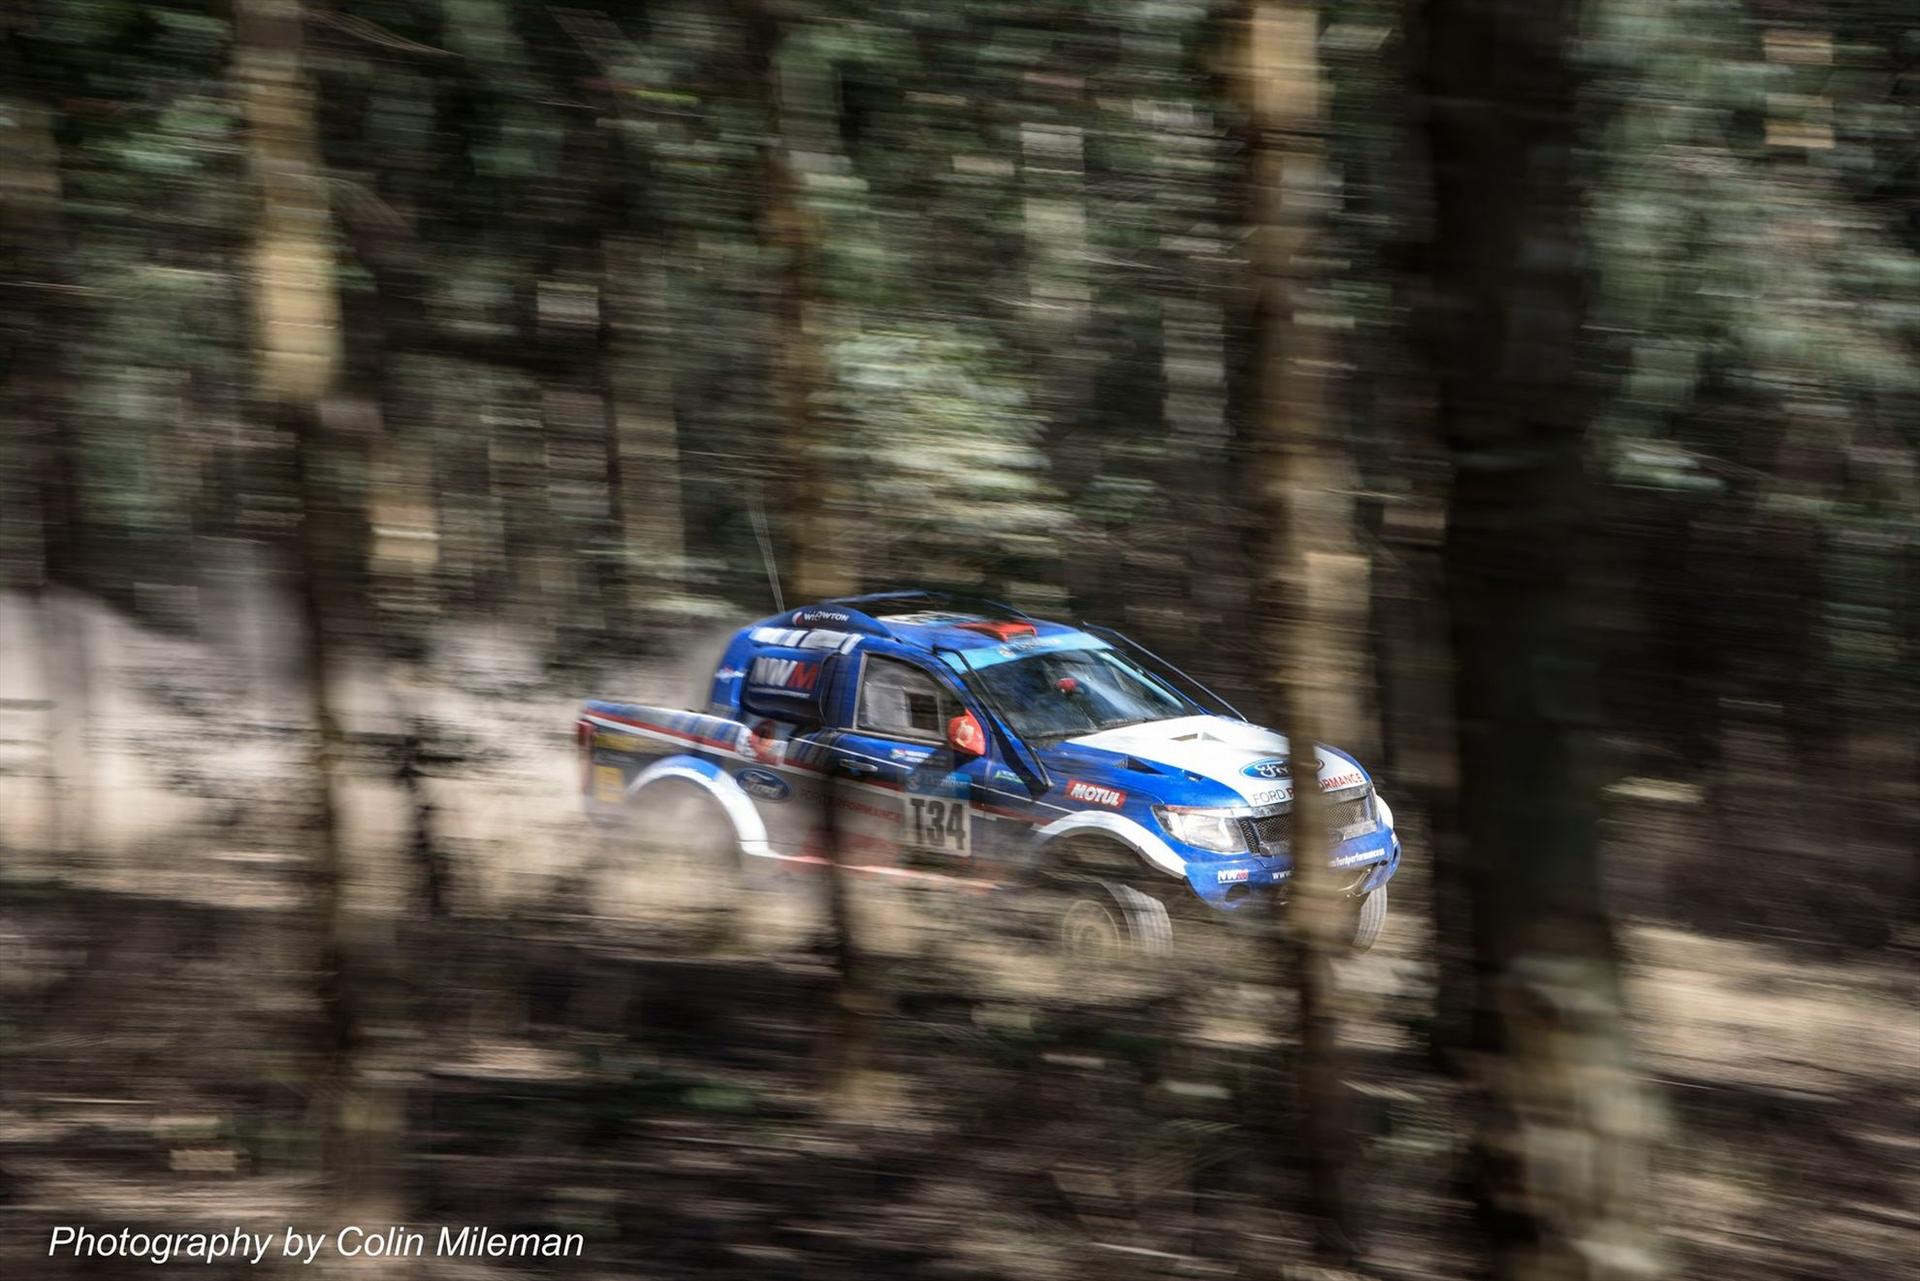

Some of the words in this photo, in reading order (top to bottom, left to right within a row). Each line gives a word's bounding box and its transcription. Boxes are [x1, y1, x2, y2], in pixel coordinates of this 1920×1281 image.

[1071, 783, 1120, 806] MOTUL
[1252, 789, 1286, 804] FORD
[910, 798, 966, 850] T34
